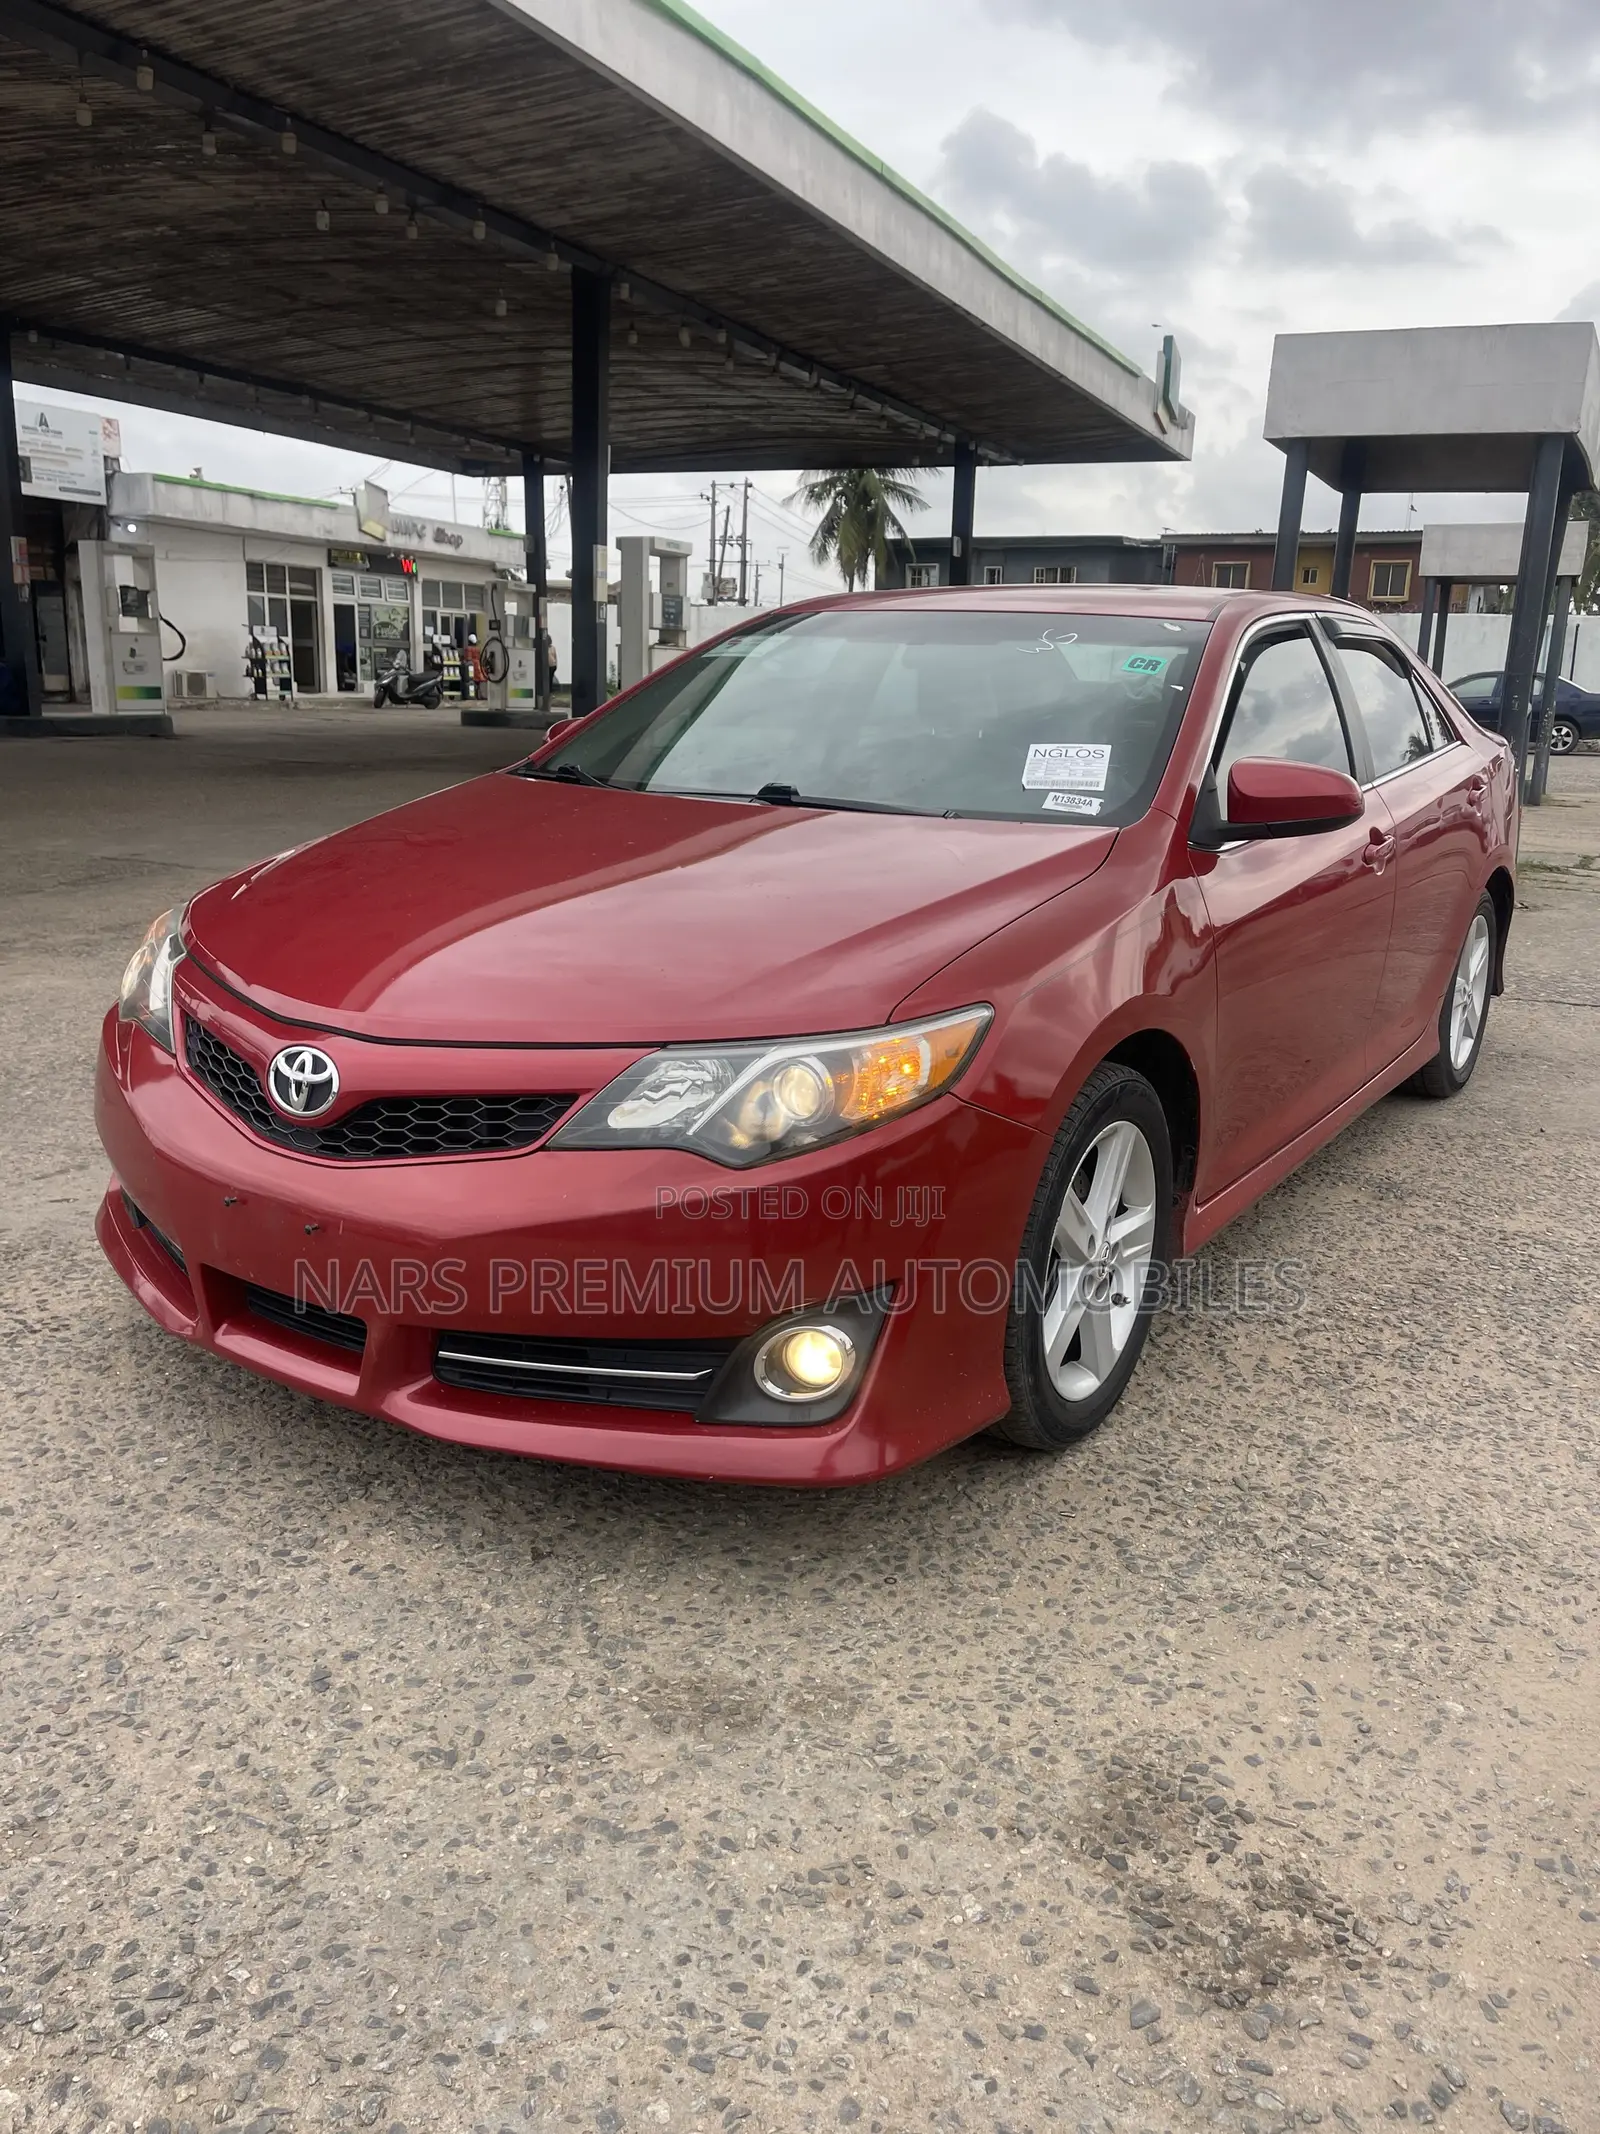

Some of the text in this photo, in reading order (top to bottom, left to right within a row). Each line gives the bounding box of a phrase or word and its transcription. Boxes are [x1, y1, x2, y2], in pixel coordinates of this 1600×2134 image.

[1127, 657, 1162, 672] CR
[1033, 748, 1105, 759] NGLOS
[1051, 794, 1093, 807] N13834A
